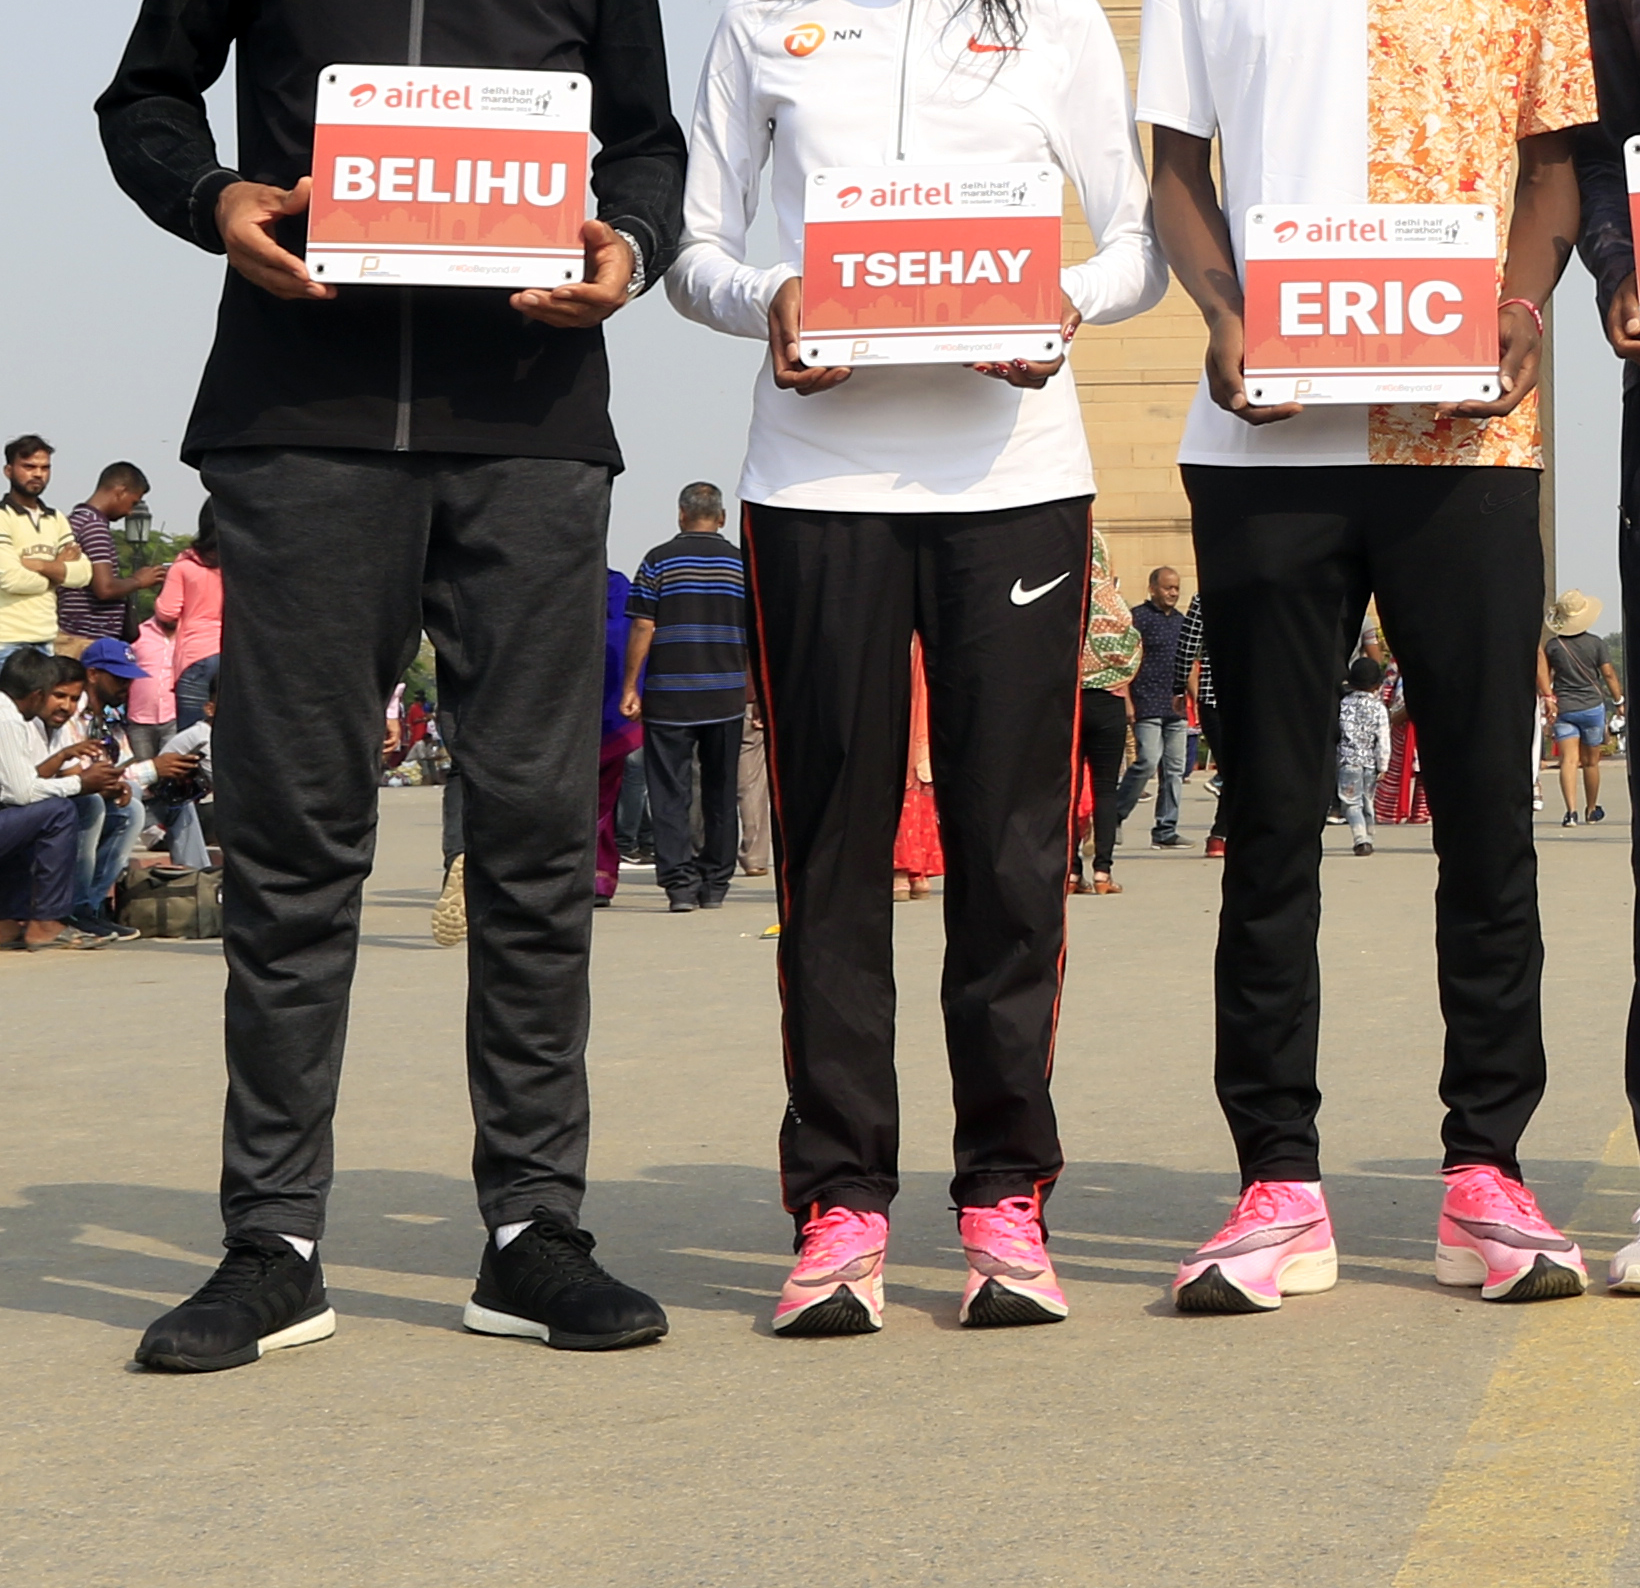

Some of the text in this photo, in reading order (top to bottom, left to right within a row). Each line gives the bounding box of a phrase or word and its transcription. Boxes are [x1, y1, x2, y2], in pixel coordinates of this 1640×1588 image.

[833, 29, 862, 41] NN
[384, 81, 473, 110] airtel
[481, 86, 534, 97] delhi half
[481, 95, 533, 104] marathon
[332, 156, 568, 206] BELIHU
[960, 181, 1010, 190] delhi half
[869, 181, 953, 207] airtel
[960, 189, 1009, 197] marathon
[1394, 219, 1443, 227] delhi half
[1306, 217, 1388, 243] airtel
[1394, 226, 1442, 235] marathon
[832, 248, 1032, 288] TSEHAY
[1279, 279, 1464, 336] ERIC
